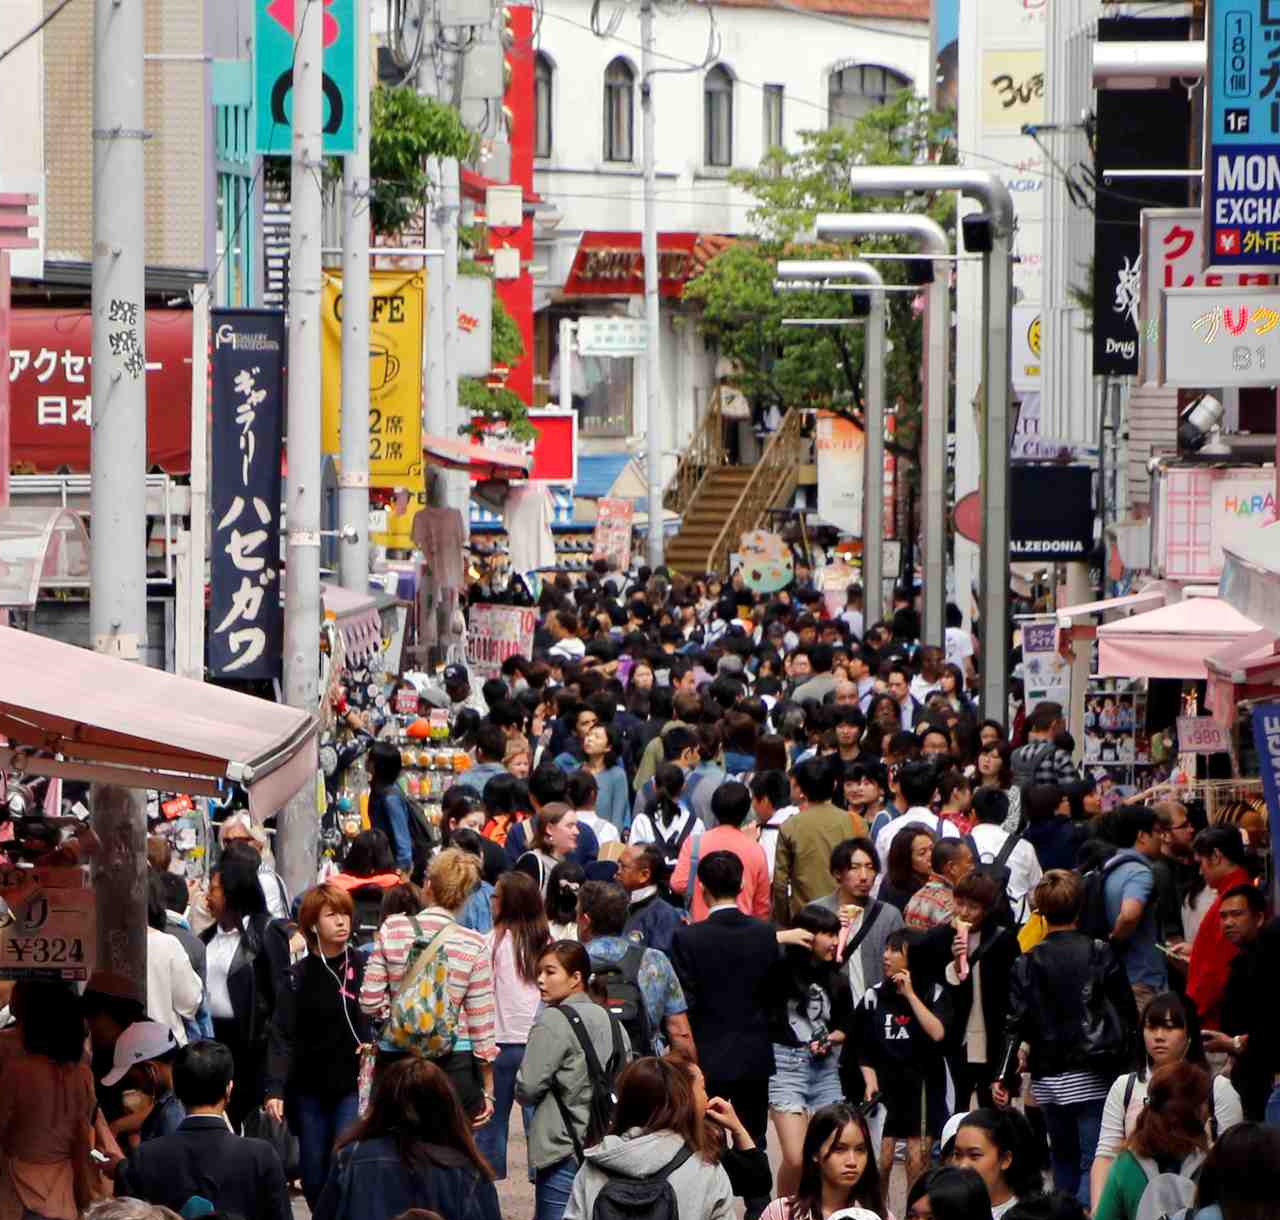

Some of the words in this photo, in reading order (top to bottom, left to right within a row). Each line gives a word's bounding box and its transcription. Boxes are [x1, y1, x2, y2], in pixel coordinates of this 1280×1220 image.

[1227, 112, 1248, 131] 1F
[1106, 338, 1135, 358] Drug
[9, 347, 162, 385] アクセー
[214, 496, 274, 671] ハセガワ
[7, 937, 85, 963] ¥324
[885, 1027, 910, 1040] LA
